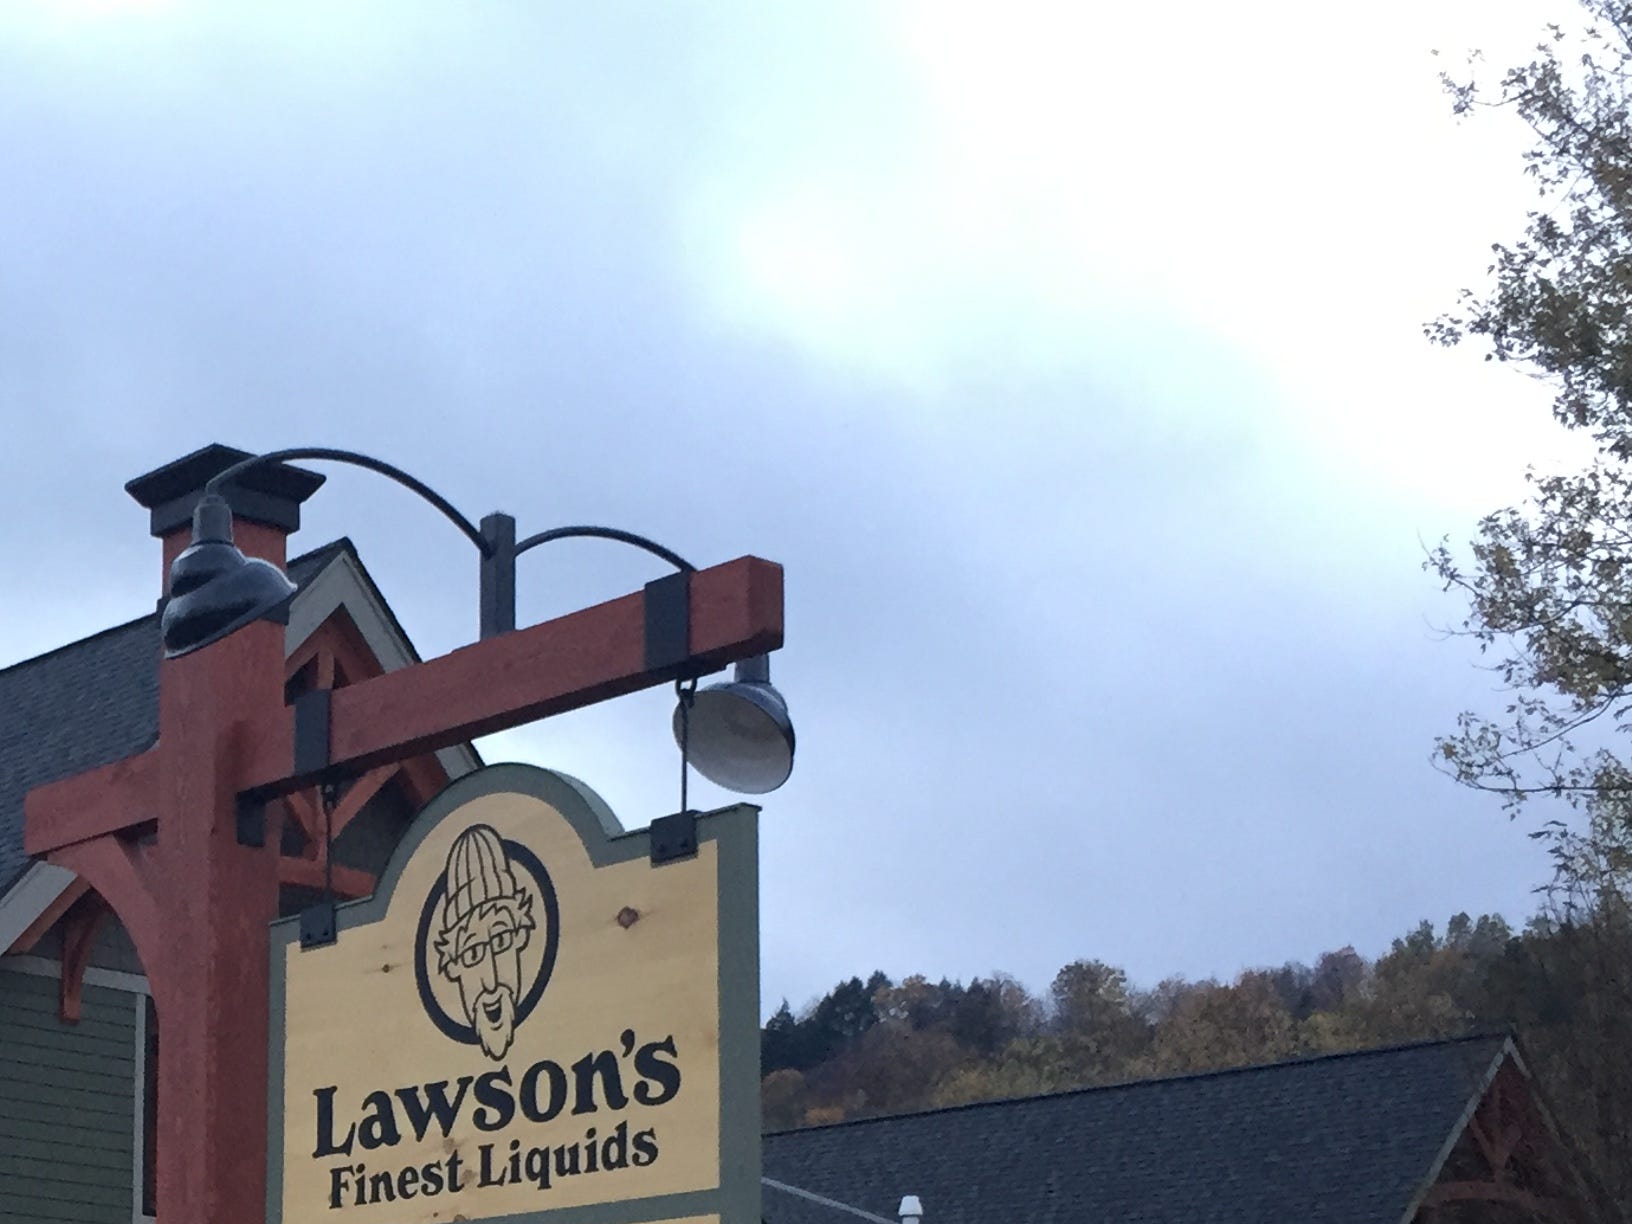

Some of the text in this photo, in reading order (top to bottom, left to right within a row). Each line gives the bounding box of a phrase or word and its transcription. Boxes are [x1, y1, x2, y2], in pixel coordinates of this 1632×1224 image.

[312, 1028, 682, 1159] Lawson's
[328, 1119, 660, 1210] Finest Liquids
